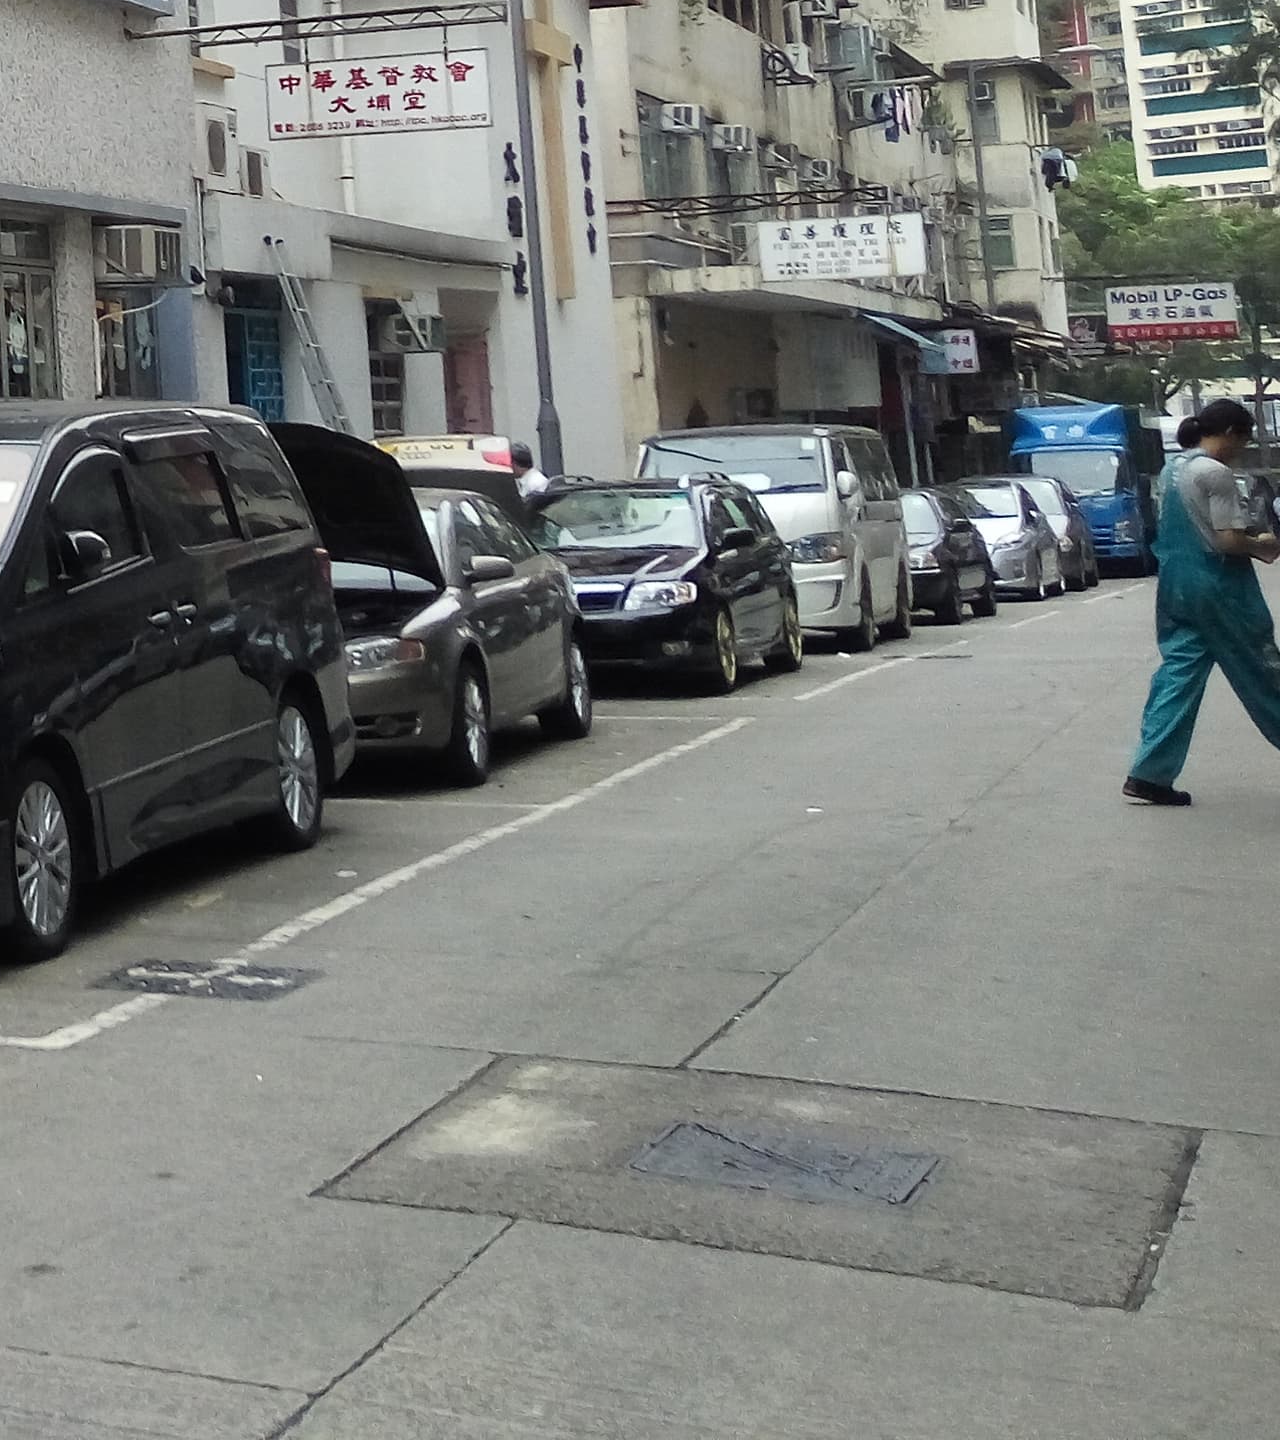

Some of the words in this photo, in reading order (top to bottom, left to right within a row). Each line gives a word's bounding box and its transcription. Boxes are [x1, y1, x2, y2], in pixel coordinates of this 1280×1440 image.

[278, 61, 475, 95] 中華基督教會
[328, 88, 427, 114] 大埔堂
[1110, 290, 1158, 304] Mobil
[1164, 288, 1228, 302] LP-Gas
